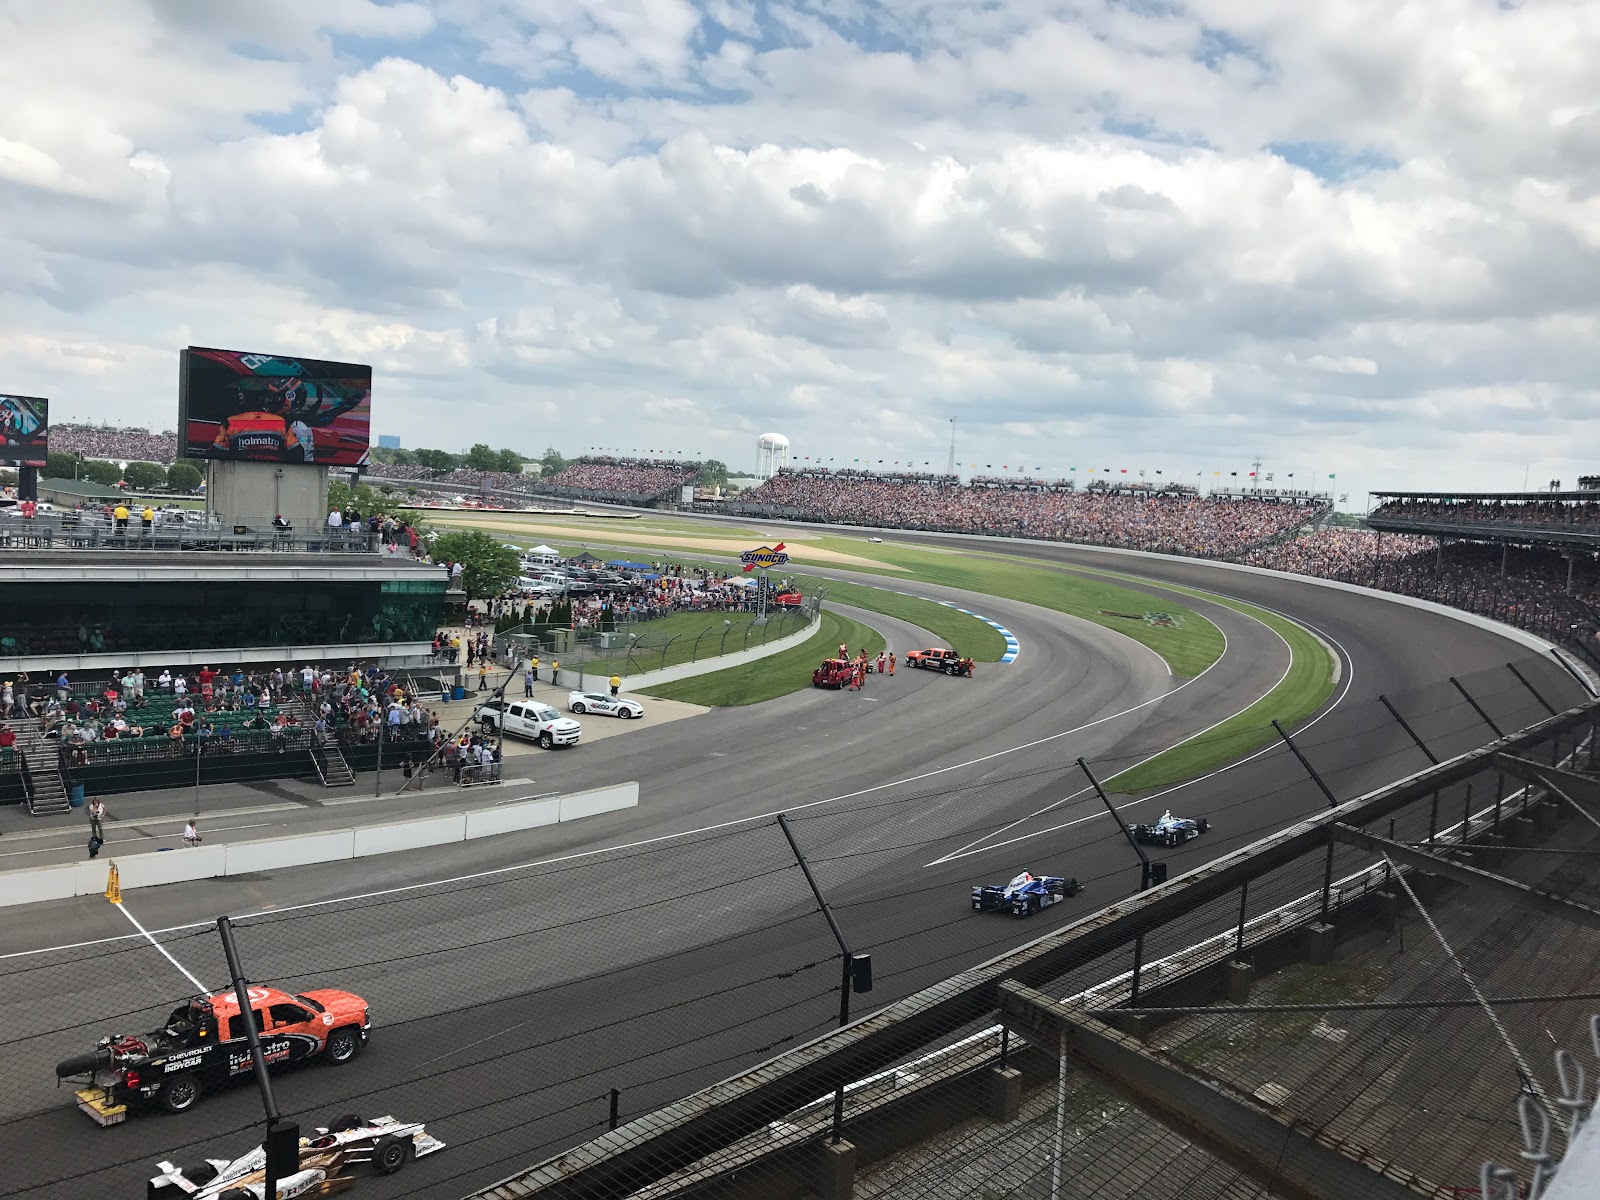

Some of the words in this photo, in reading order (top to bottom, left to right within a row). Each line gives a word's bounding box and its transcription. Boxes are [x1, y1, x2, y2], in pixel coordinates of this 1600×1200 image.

[238, 436, 280, 447] holmatro
[744, 553, 785, 562] SUNOCO
[168, 1045, 213, 1062] CHEVROLET
[164, 1057, 202, 1074] INDYCAR
